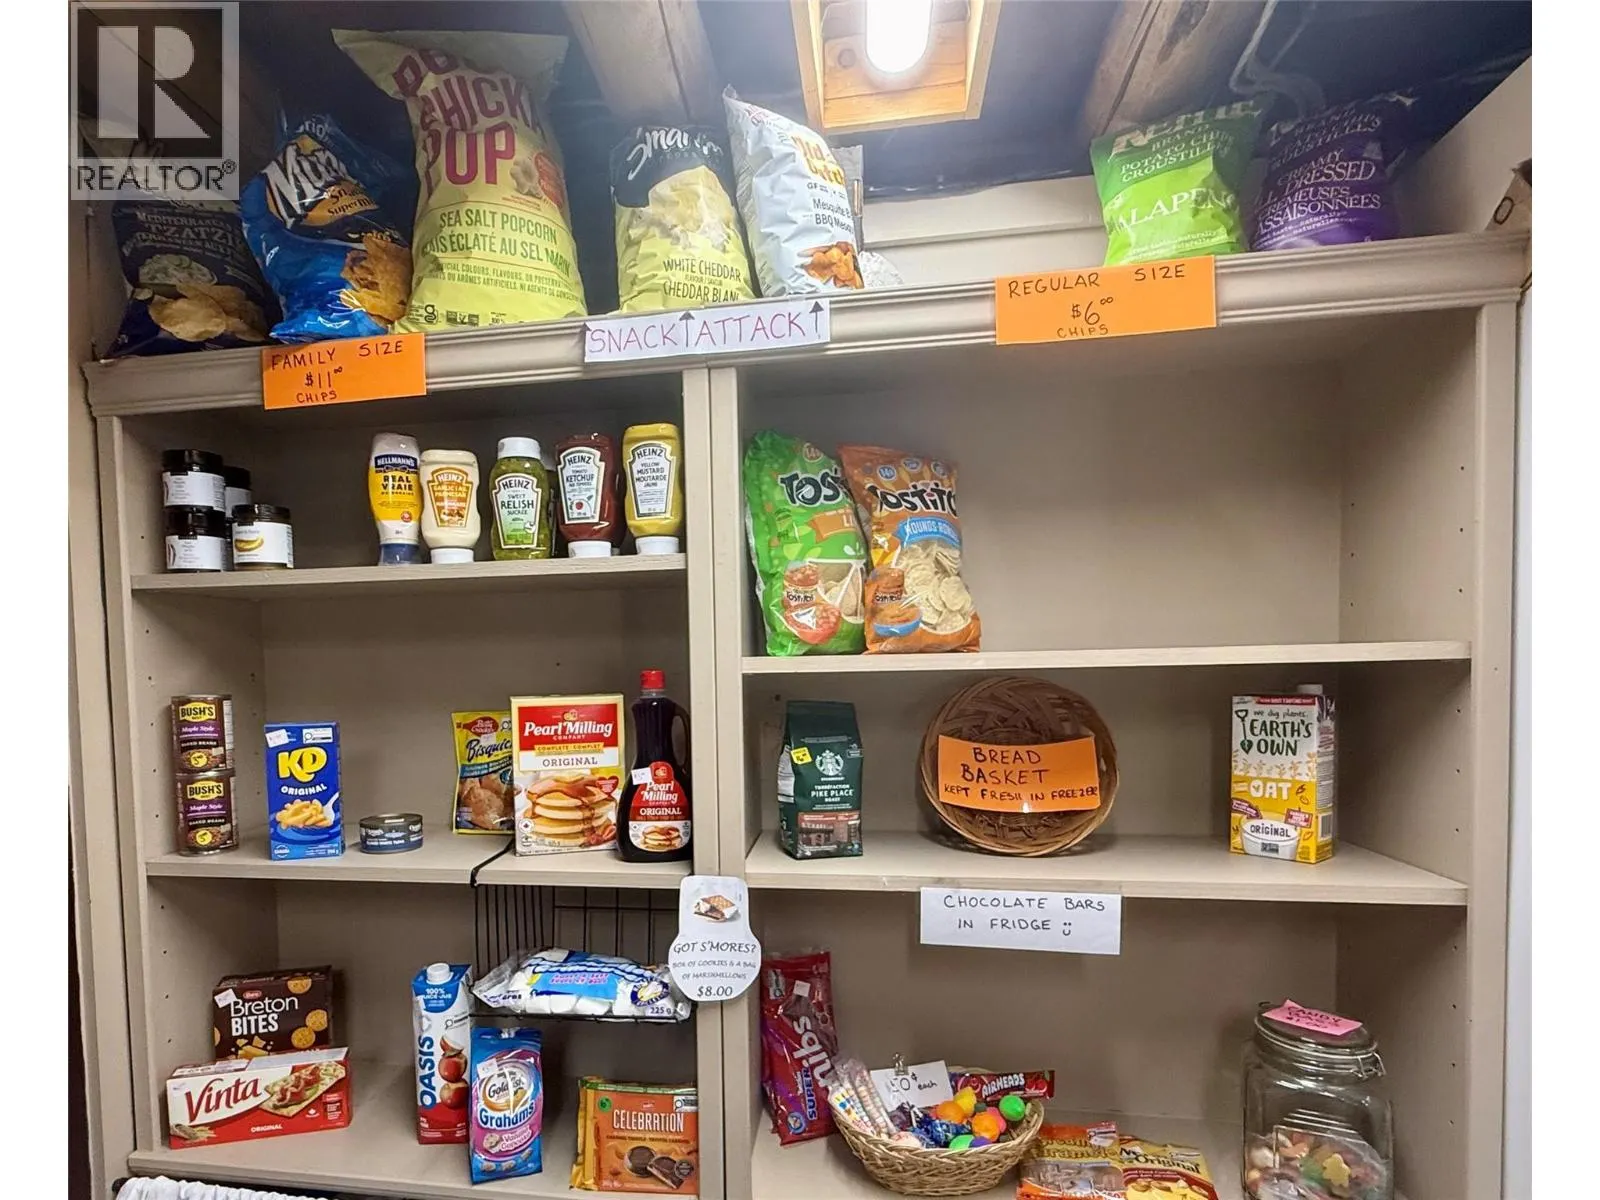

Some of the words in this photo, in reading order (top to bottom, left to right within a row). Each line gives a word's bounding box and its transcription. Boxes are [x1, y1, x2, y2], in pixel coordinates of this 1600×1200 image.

[1285, 160, 1376, 196] DRESSED
[440, 211, 463, 229] SEA
[465, 208, 498, 228] SALT
[501, 212, 558, 245] POPCORN
[815, 213, 834, 228] BBQ
[450, 231, 497, 253] ÉCLATÉ
[500, 237, 517, 257] AU
[520, 240, 543, 262] SEL
[663, 259, 696, 273] WHITE
[699, 260, 741, 283] CHEDDAR
[1008, 272, 1100, 298] REGULAR
[1134, 263, 1185, 282] SIZE
[663, 280, 710, 302] CHEDDAR
[589, 323, 676, 353] SNACK
[695, 312, 806, 347] ATTACK
[1056, 324, 1109, 338] CHIPS
[271, 348, 336, 371] FAMILY
[358, 340, 404, 357] SIZE
[296, 390, 338, 404] CHIPS
[567, 455, 592, 466] HEINZ
[637, 448, 664, 459] HEINZ
[438, 473, 462, 481] HEINZ
[566, 474, 594, 482] KETCHUP
[637, 467, 664, 475] MUSTARD
[383, 475, 411, 483] REAL
[502, 479, 530, 490] HEINZ
[636, 475, 667, 483] MOUTARDE
[382, 483, 413, 491] VRAIE
[501, 500, 534, 509] RELISH
[181, 707, 215, 719] BUSH'S
[182, 725, 199, 733] Maple
[523, 721, 562, 736] Pearl
[562, 720, 613, 738] Milling
[1249, 719, 1312, 738] EARTH'S
[466, 738, 512, 763] Bisquic
[1256, 738, 1298, 757] OWN
[542, 756, 598, 768] ORIGINAL
[973, 747, 1041, 765] BREAD
[277, 746, 328, 783] KD
[960, 763, 1049, 786] BASKET
[188, 784, 223, 797] BUSH'S
[280, 783, 328, 796] ORIGINAL
[646, 781, 674, 792] Pearl
[811, 790, 829, 798] PIKE
[830, 789, 853, 797] PLACE
[944, 783, 971, 797] KEPT
[981, 789, 1023, 801] FRESH
[1030, 793, 1045, 801] IN
[1250, 779, 1292, 800] OAT
[641, 790, 678, 804] Milling
[639, 807, 682, 816] ORIGINAL
[944, 894, 1048, 909] CHOCOLATE
[1064, 897, 1105, 912] BARS
[958, 919, 973, 929] IN
[990, 918, 1051, 931] FRIDGE
[673, 941, 697, 954] GOT
[700, 940, 757, 954] S'MORES?
[697, 985, 733, 997] $8.00
[230, 996, 299, 1018] Breton
[231, 1014, 279, 1037] BITES
[418, 1035, 438, 1109] OASIS
[917, 1082, 937, 1090] each
[981, 1072, 1025, 1098] AIRHEADS
[185, 1077, 262, 1123] Vinta
[479, 1101, 534, 1128] Grahams
[613, 1109, 684, 1132] CELEBRATION
[250, 1123, 283, 1133] ORIGINAL
[1135, 1154, 1201, 1174] Original
